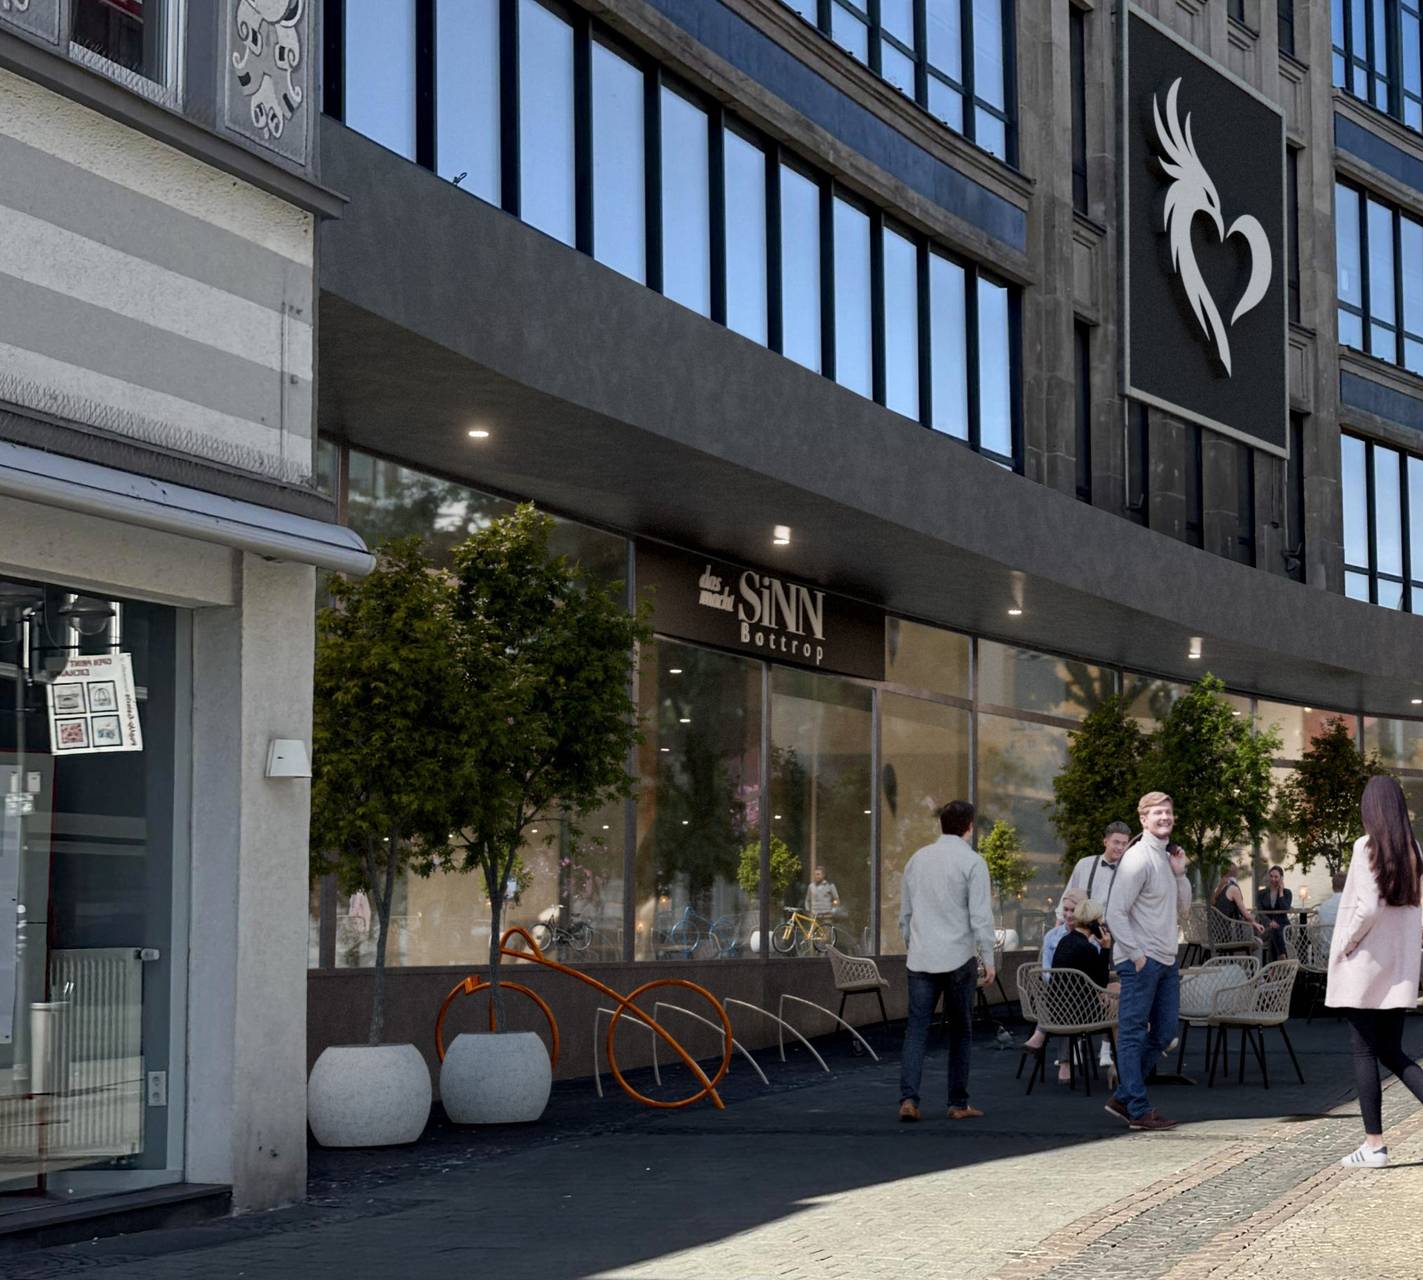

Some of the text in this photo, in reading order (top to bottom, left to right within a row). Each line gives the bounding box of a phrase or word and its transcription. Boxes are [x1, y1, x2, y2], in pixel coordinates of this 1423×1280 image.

[699, 564, 722, 591] das
[738, 571, 827, 640] SiNN
[740, 622, 824, 665] Bottrop
